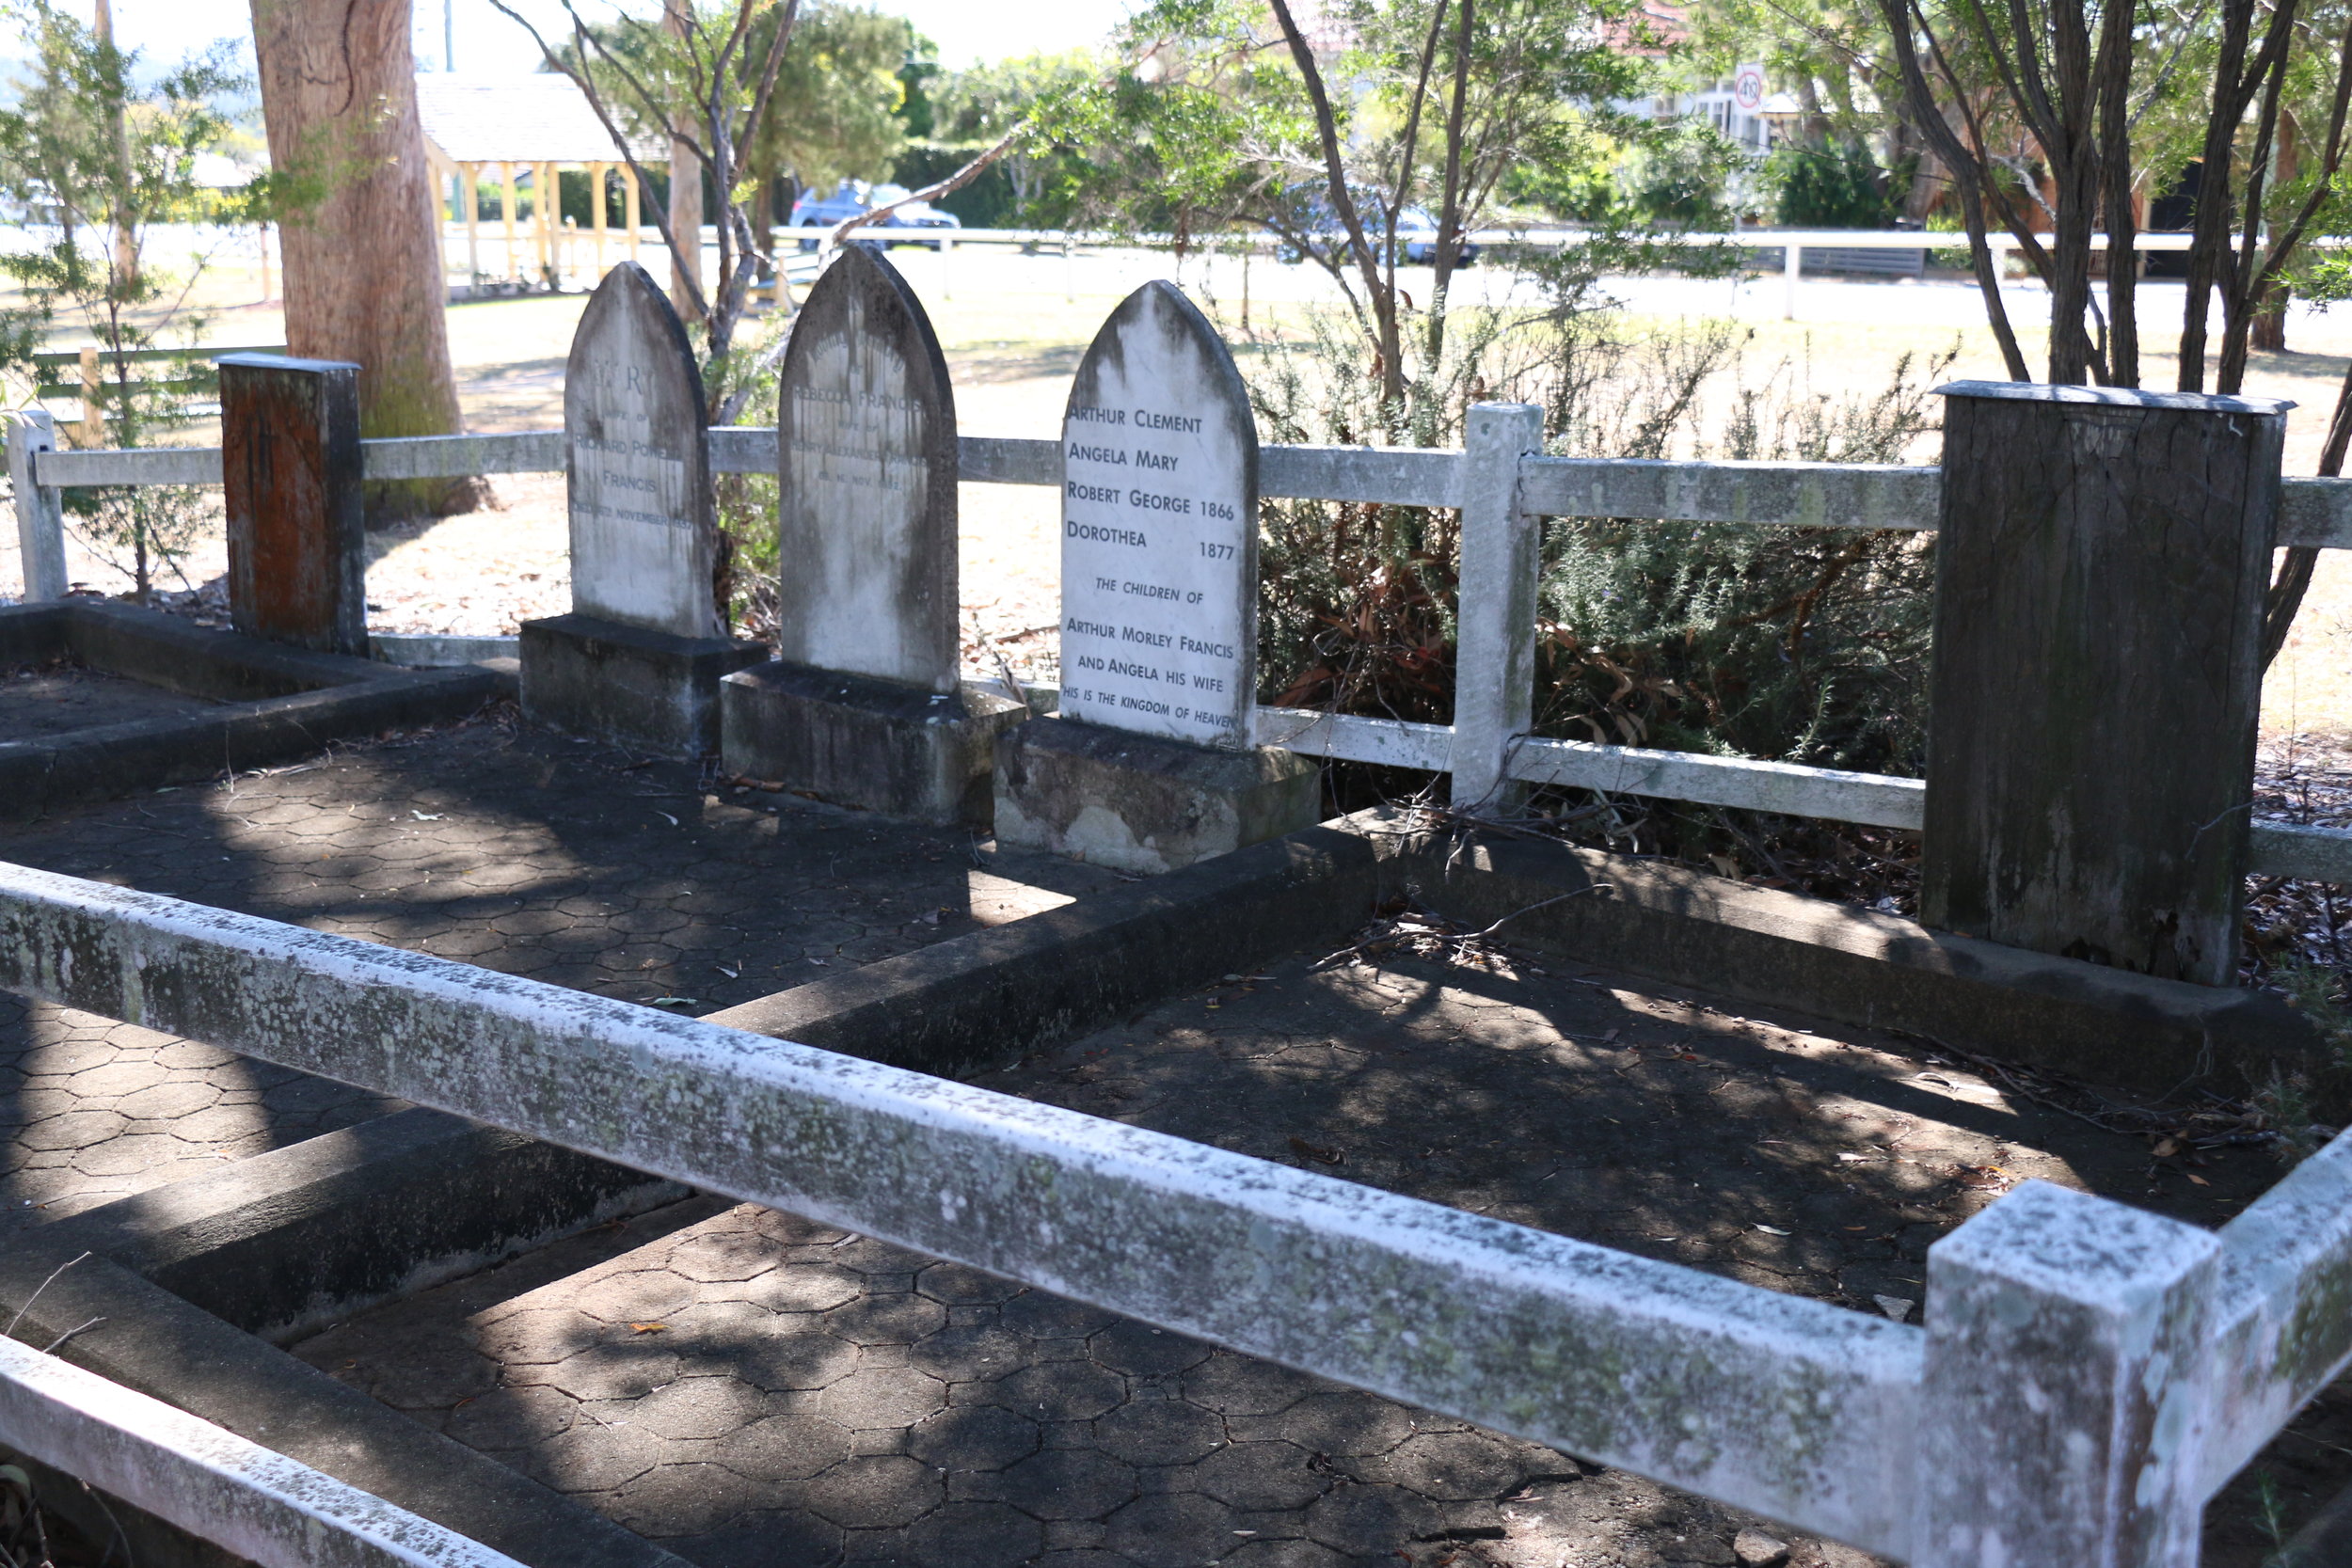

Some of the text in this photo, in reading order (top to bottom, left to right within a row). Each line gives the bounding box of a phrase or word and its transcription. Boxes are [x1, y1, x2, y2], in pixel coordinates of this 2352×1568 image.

[1740, 82, 1757, 99] 40
[1068, 406, 1202, 433] ARTHUR CLEMENT
[1069, 443, 1178, 471] ANGELA MARY
[604, 470, 657, 493] FRANCIS
[1068, 482, 1234, 521] ROBERT GEORGE 1866
[616, 509, 668, 526] NOVEMBER
[1068, 521, 1234, 561] DOROTHEA 1877
[1096, 578, 1203, 605] THE CHILDREN OF
[1067, 617, 1233, 658] ARTHUR MORLEY FRANCIS
[1078, 656, 1224, 692] AND ANGELA HIS WIFE
[1084, 689, 1092, 701] IS
[1098, 692, 1116, 705] THE
[1120, 696, 1169, 716] KINGDOM
[1175, 707, 1189, 719] OF
[1194, 710, 1235, 729] HEAVEN
